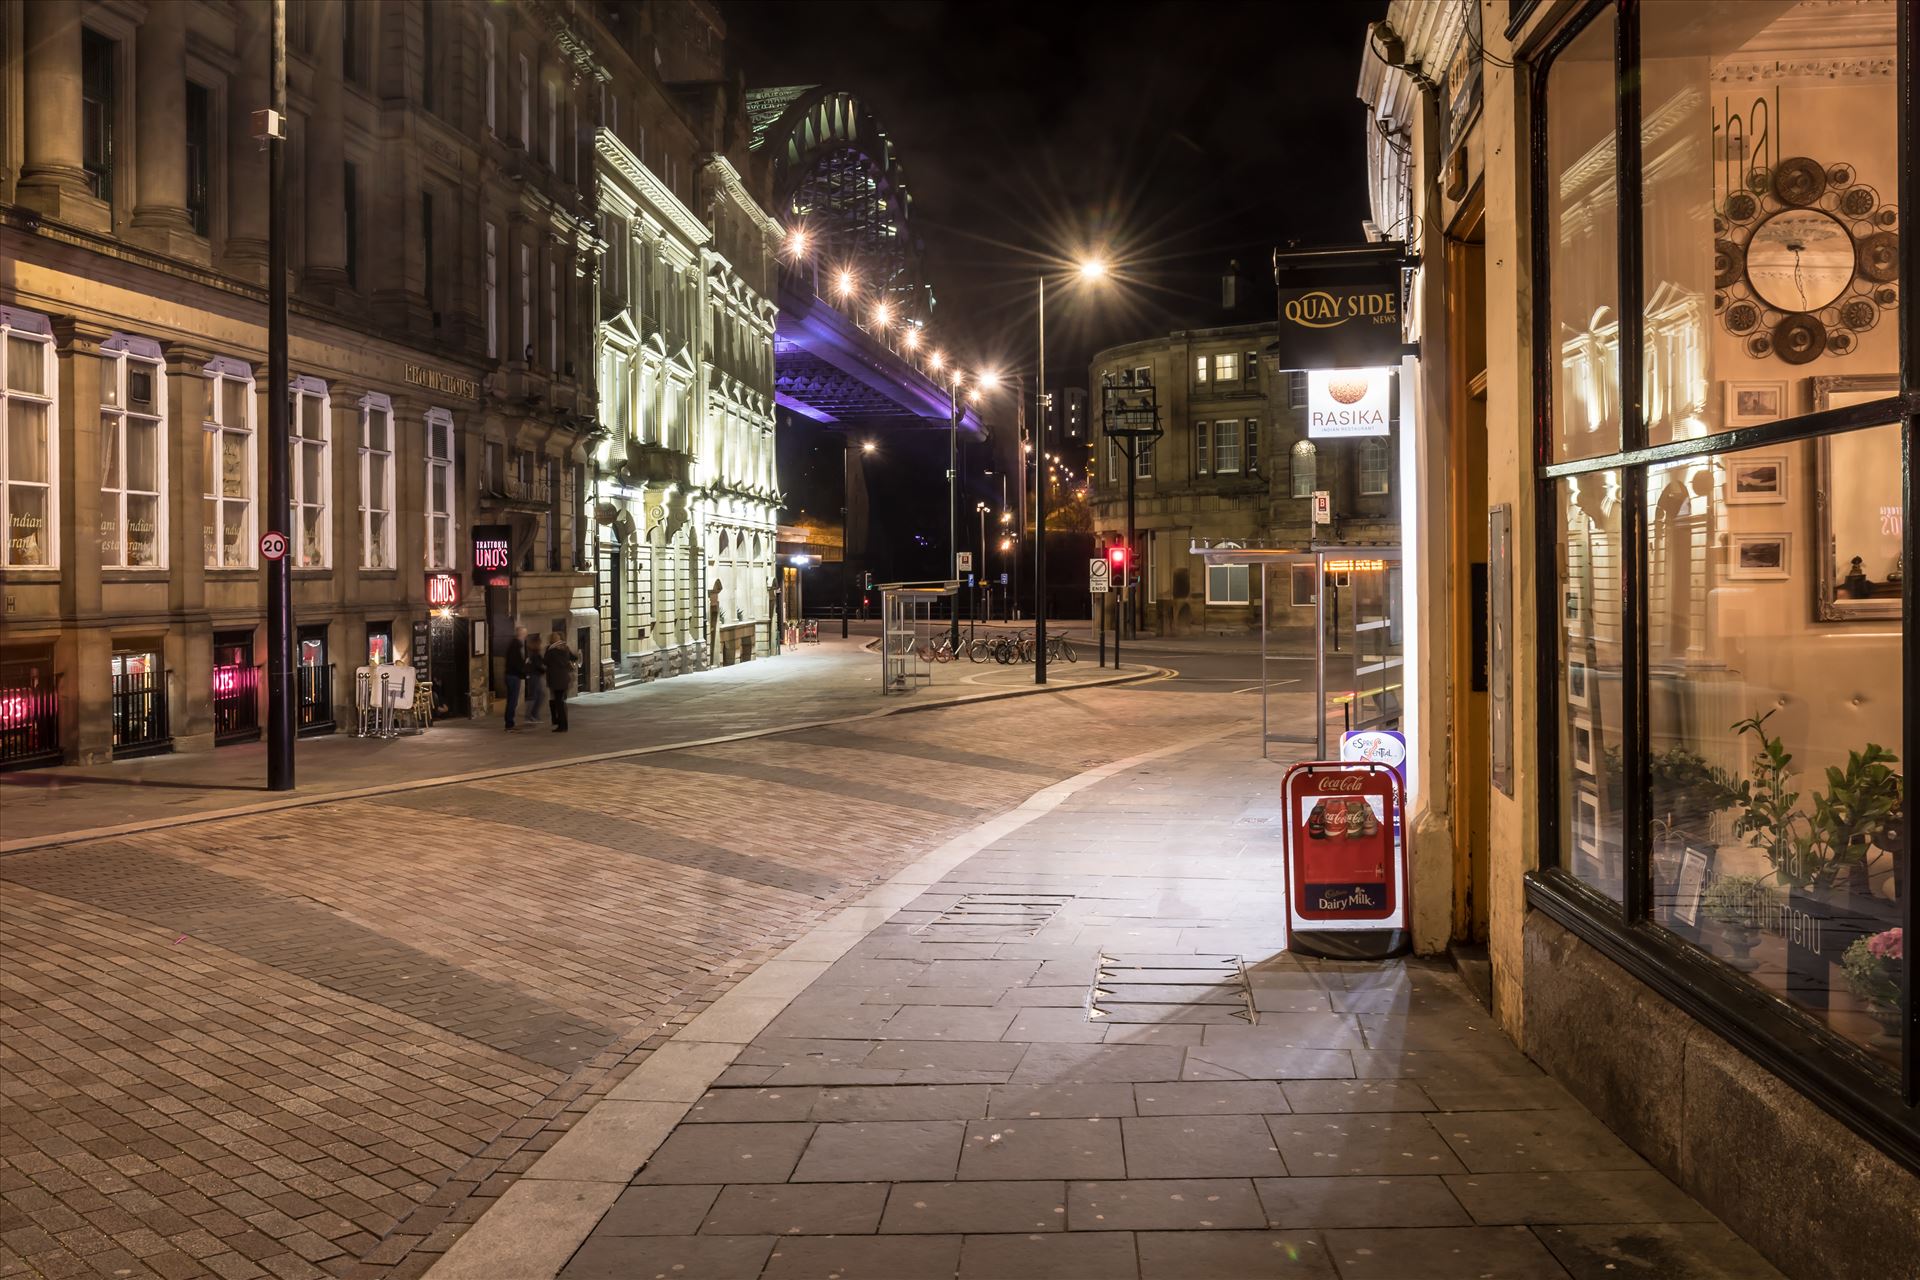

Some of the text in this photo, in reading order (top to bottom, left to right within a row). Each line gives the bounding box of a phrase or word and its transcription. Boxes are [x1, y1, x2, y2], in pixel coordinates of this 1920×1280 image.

[1285, 293, 1396, 325] QUAY SIDE
[1373, 315, 1396, 325] NEWS
[1313, 410, 1383, 426] RASIKA
[263, 540, 284, 552] 20
[476, 541, 508, 549] TRATTORIA
[476, 549, 508, 567] UNO'S
[430, 578, 455, 603] UNO'S
[1318, 776, 1364, 791] Coca-Cola
[1319, 898, 1347, 910] Dairy
[1779, 902, 1821, 956] menu
